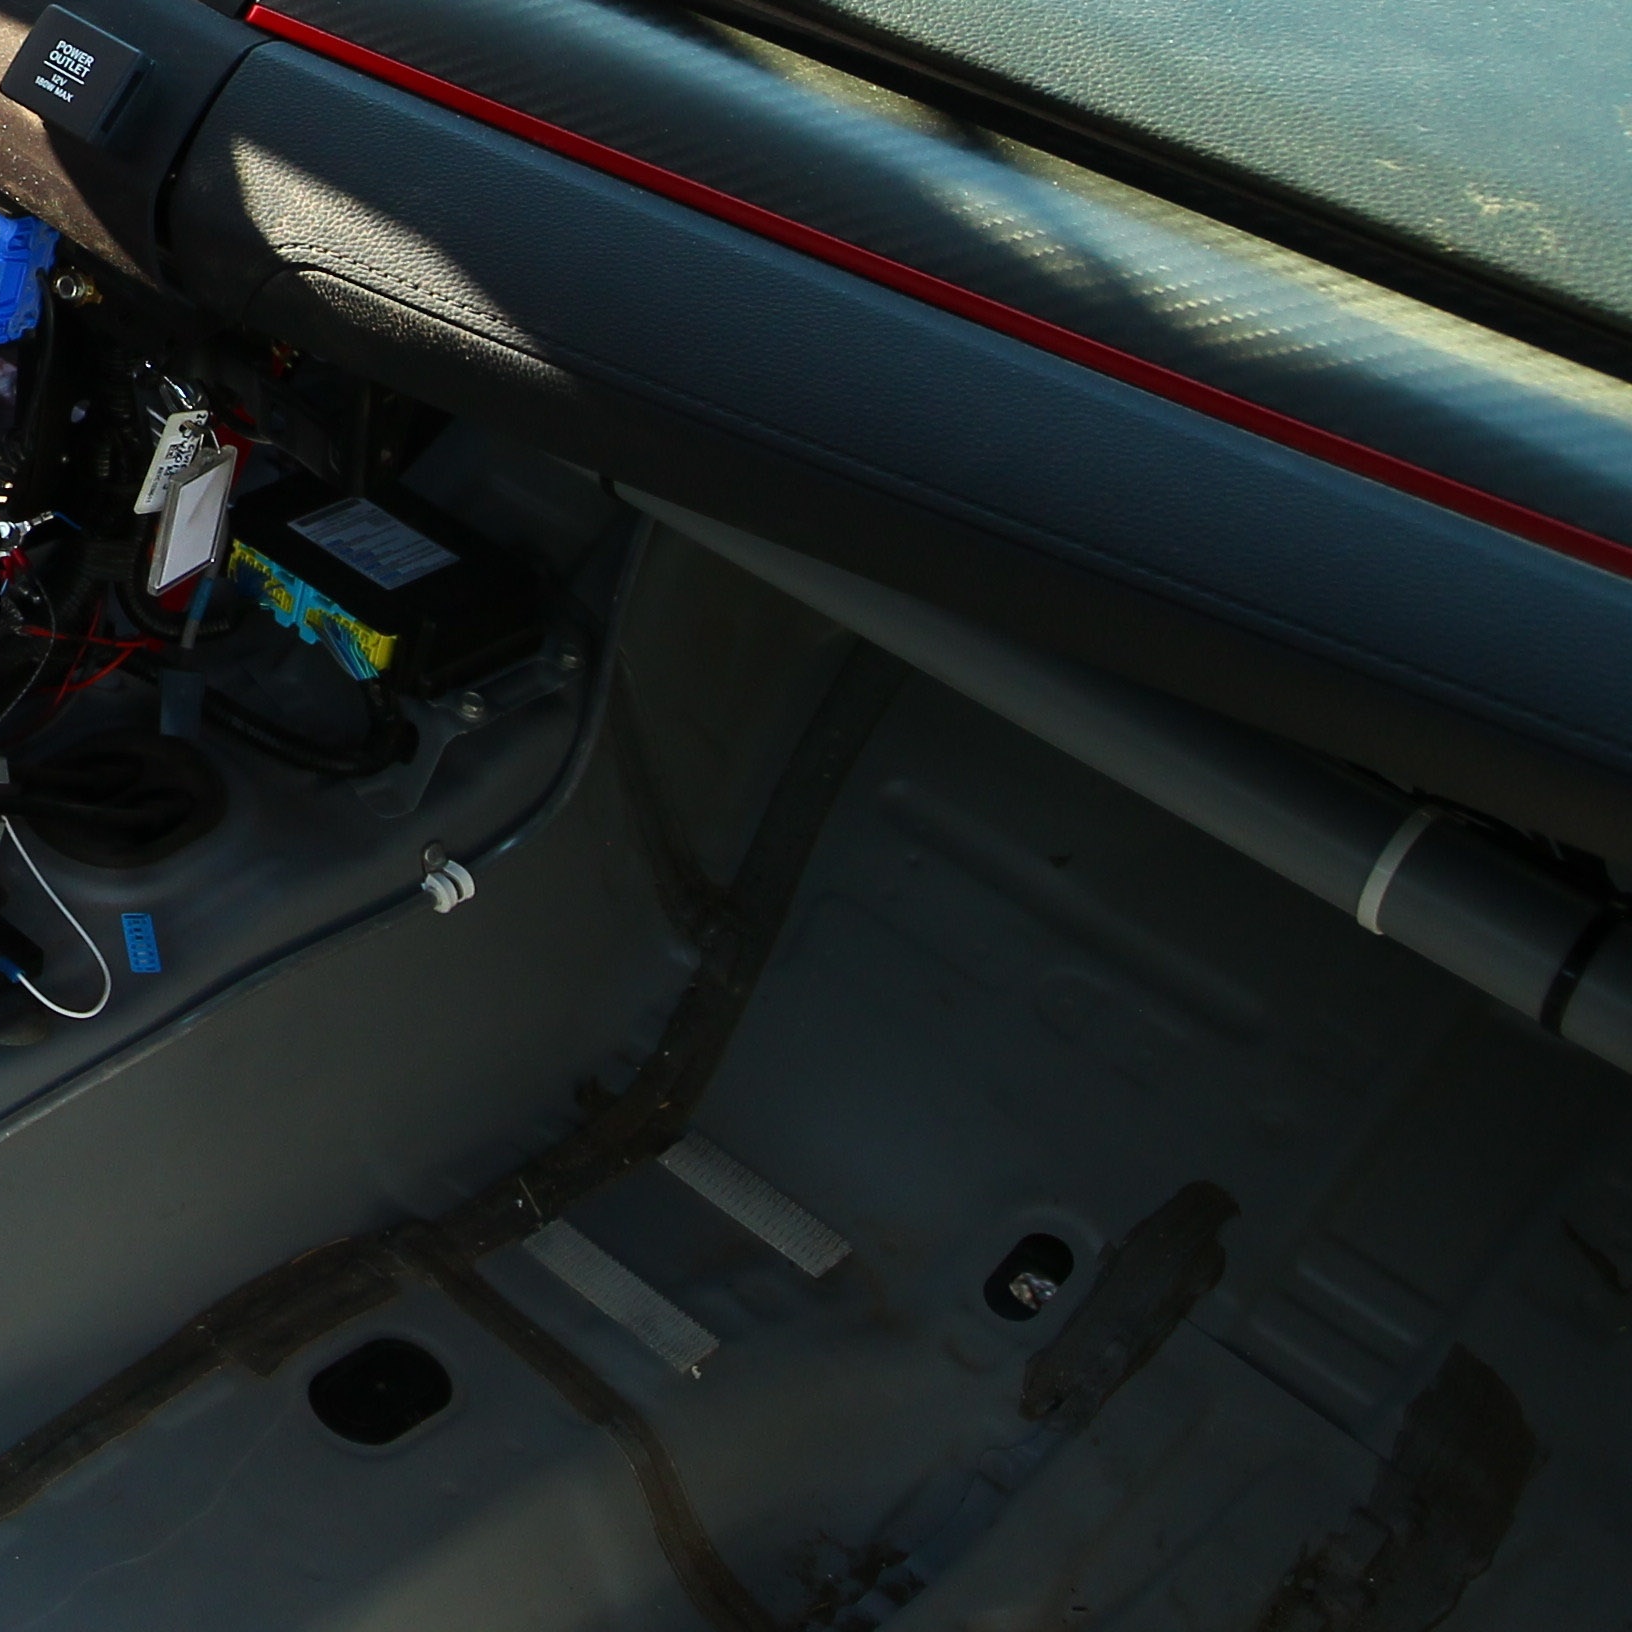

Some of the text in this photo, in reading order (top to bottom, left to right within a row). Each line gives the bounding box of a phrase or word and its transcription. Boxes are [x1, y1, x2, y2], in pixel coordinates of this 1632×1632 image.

[49, 50, 91, 78] OUTLET
[56, 39, 95, 68] POWER
[53, 86, 74, 103] MAX
